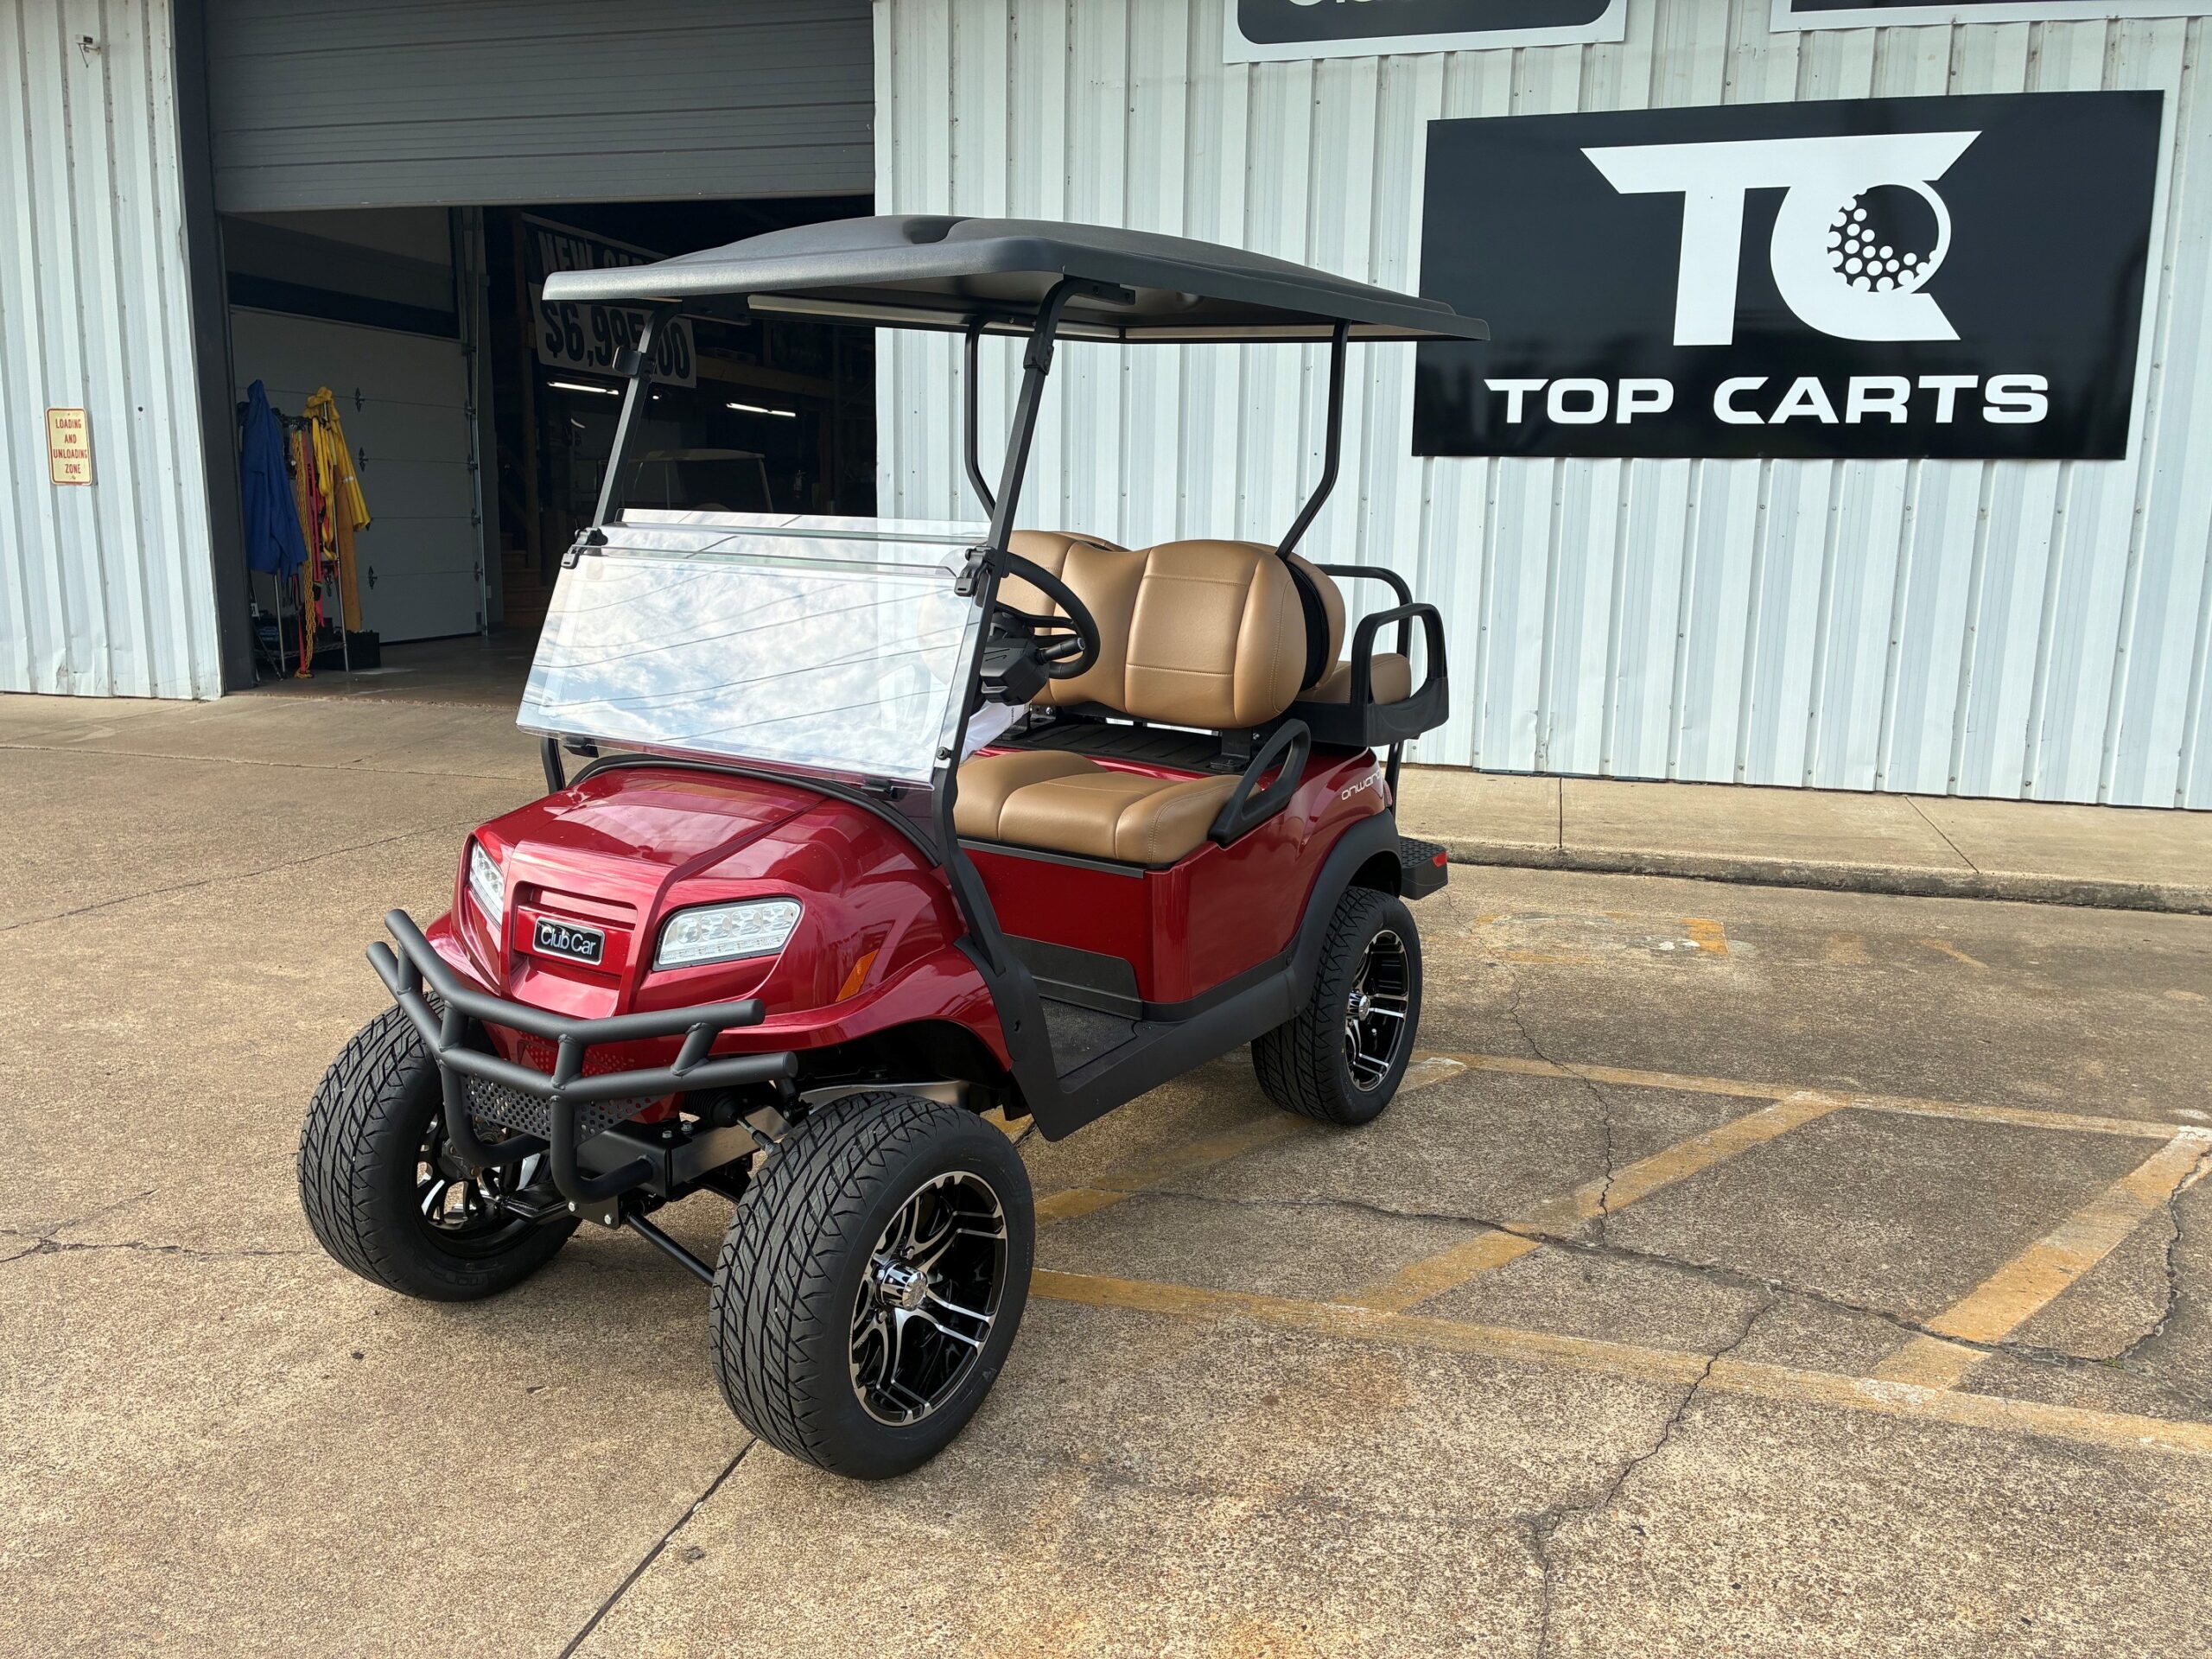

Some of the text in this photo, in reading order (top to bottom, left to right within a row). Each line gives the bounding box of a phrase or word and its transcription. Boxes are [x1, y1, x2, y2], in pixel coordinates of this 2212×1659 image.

[541, 302, 690, 379] $6,9900
[1484, 373, 2049, 424] TOP CARTS
[55, 418, 82, 429] LOADING
[64, 434, 78, 444] AND
[53, 448, 88, 459] UNLOADING
[65, 463, 82, 474] ZONE
[540, 925, 596, 955] Club Car
